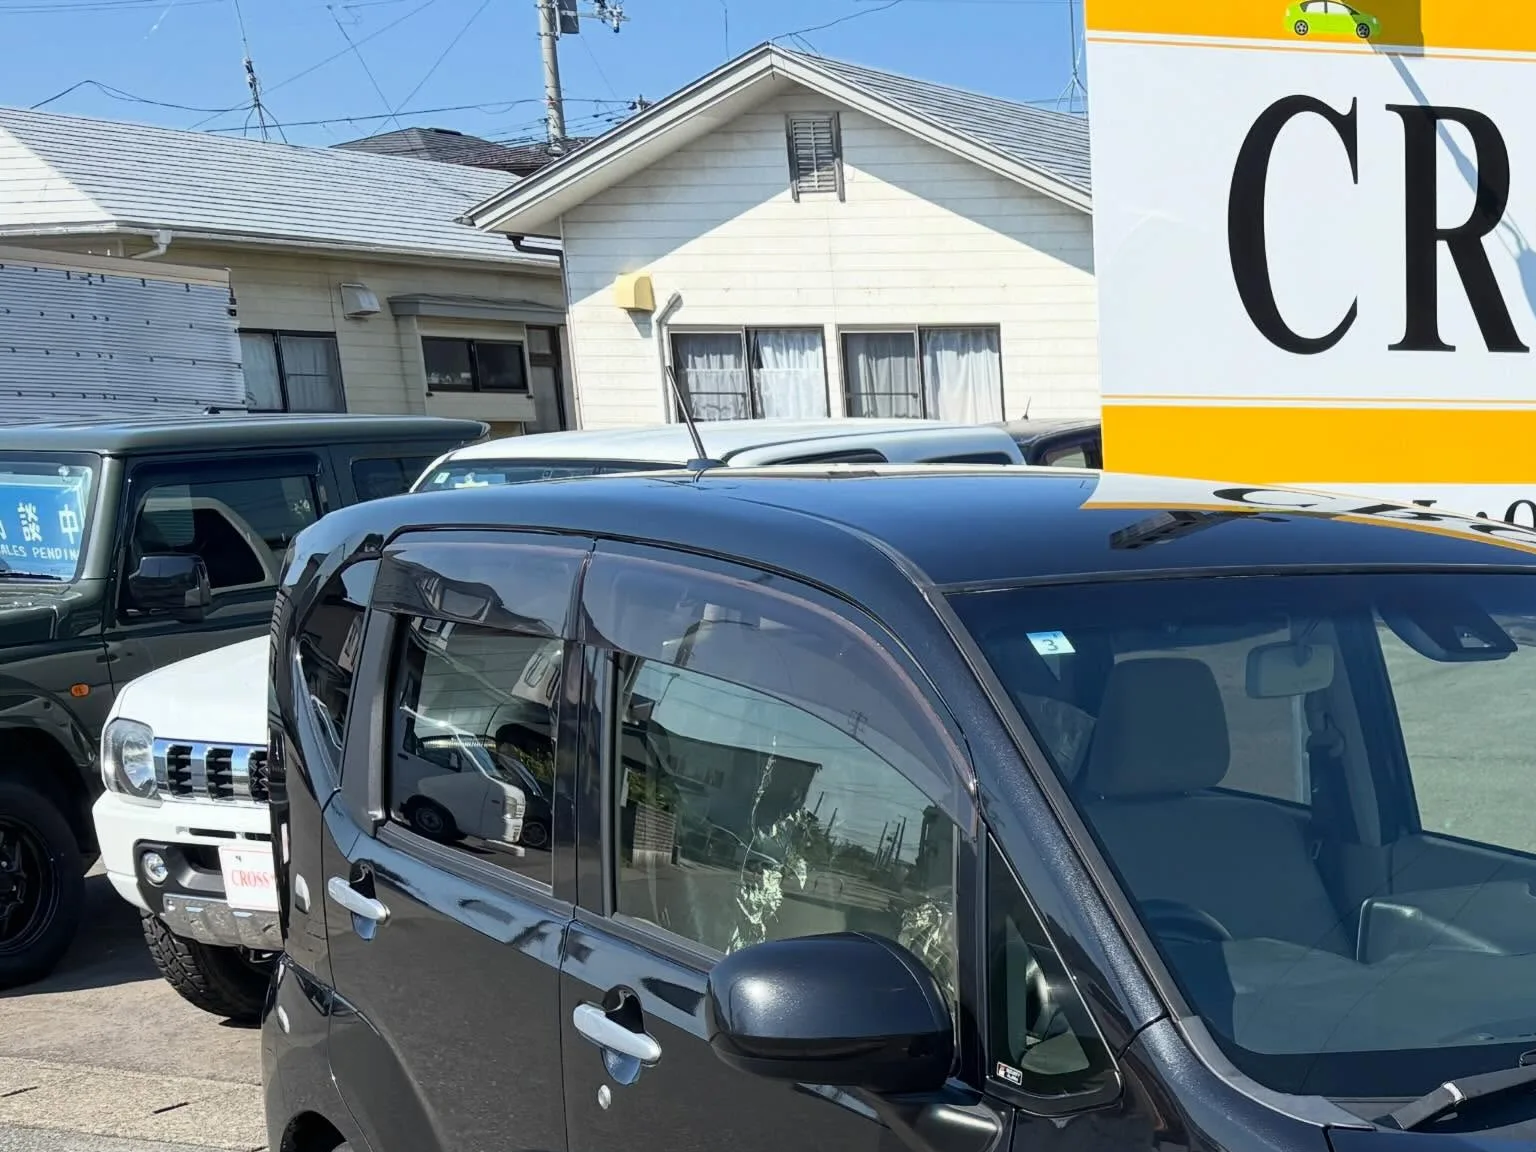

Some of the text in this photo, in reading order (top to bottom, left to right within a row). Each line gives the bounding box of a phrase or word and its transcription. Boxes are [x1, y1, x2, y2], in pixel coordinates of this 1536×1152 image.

[0, 502, 80, 545] 談中
[0, 544, 79, 560] ALES PENDIN
[1042, 639, 1059, 651] 3
[231, 869, 271, 889] CROSS
